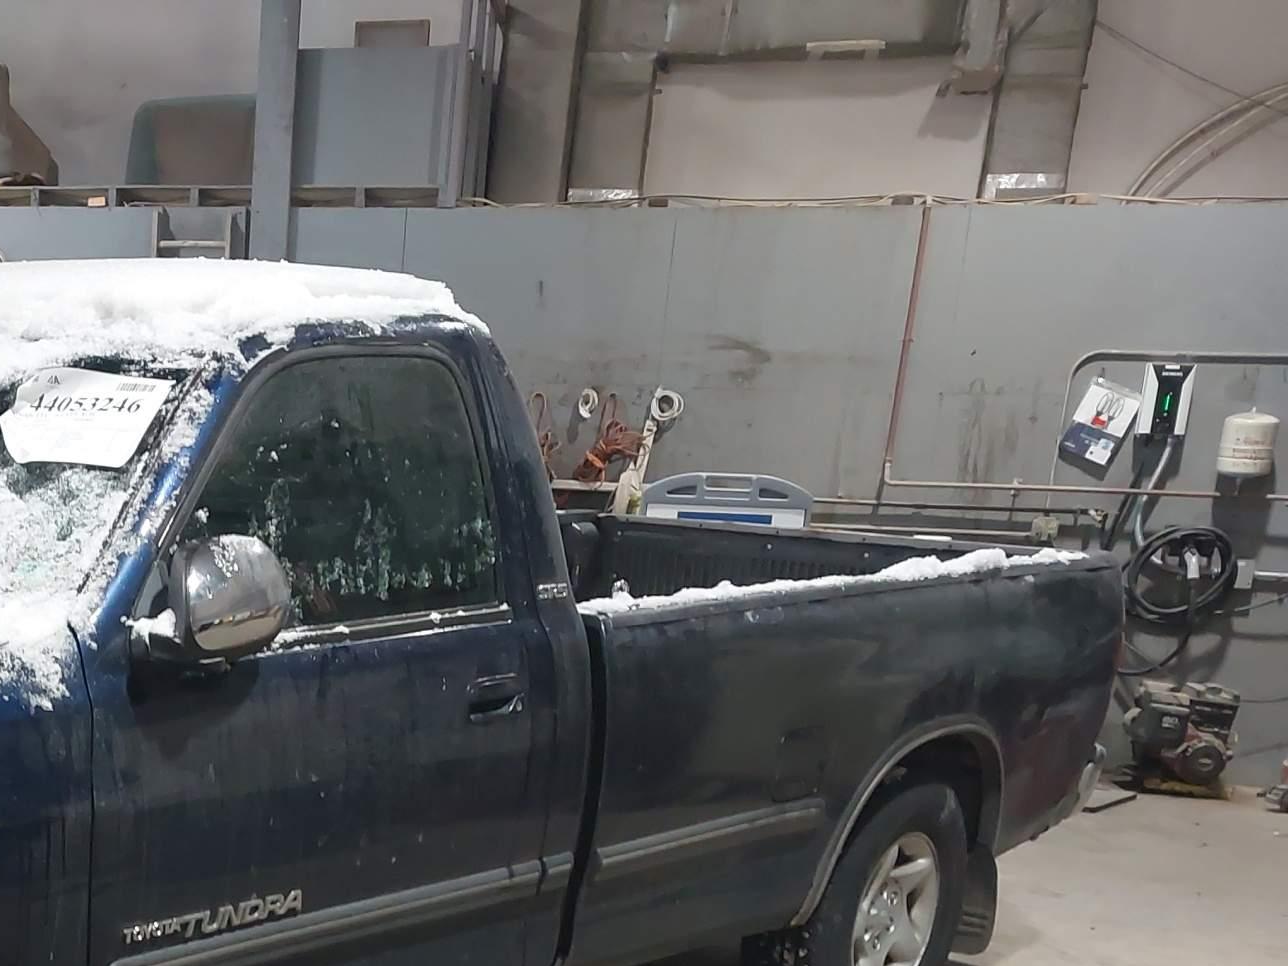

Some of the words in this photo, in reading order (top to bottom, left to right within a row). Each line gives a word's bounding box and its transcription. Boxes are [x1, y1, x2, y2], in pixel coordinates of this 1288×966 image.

[30, 393, 144, 413] 44053246
[123, 917, 181, 945] TOYOTA
[176, 889, 303, 938] TUNDRA
